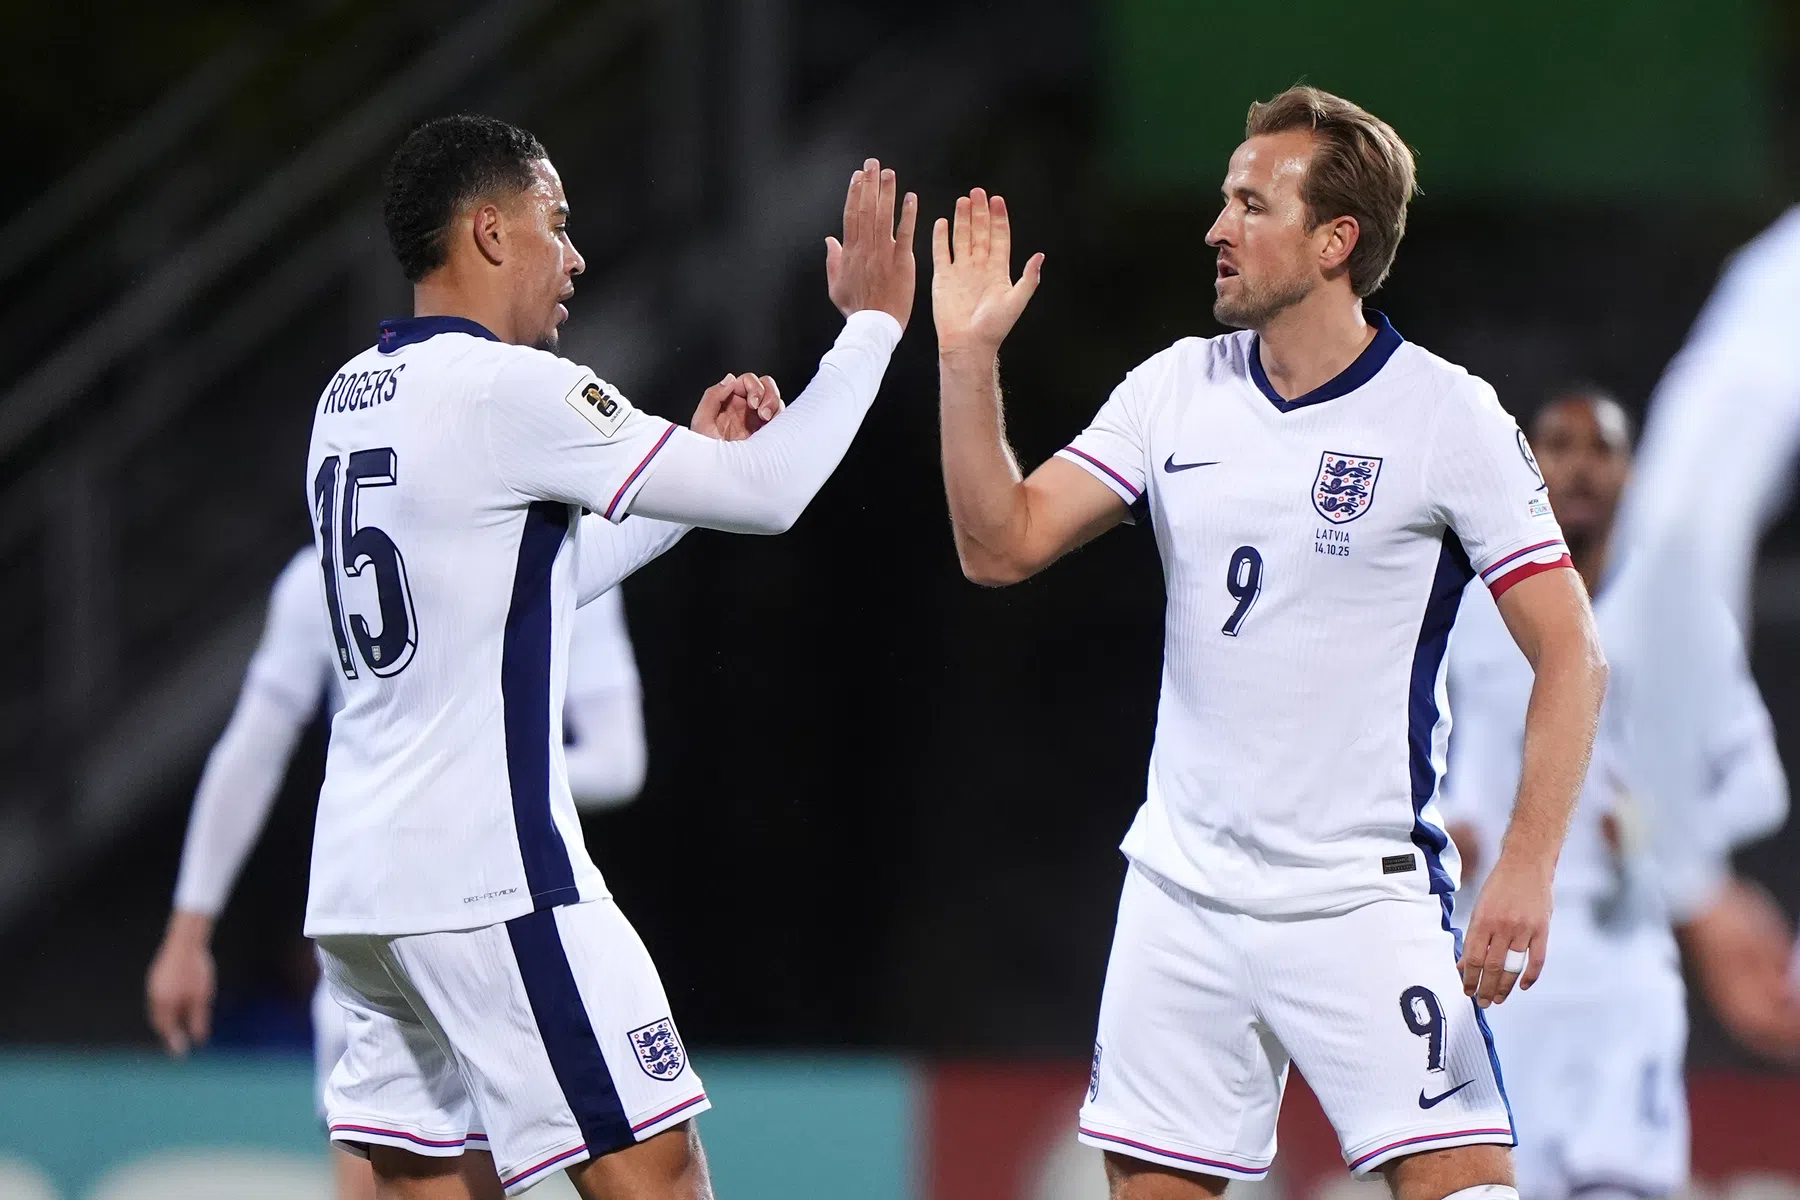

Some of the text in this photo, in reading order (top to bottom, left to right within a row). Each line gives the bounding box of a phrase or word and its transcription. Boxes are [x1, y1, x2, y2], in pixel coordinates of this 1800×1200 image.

[323, 363, 406, 414] ROGERS
[315, 447, 418, 680] 15
[1314, 541, 1350, 557] 14.10.25
[1315, 527, 1350, 543] LATVIA
[1221, 545, 1264, 637] 9
[1399, 984, 1447, 1074] 9
